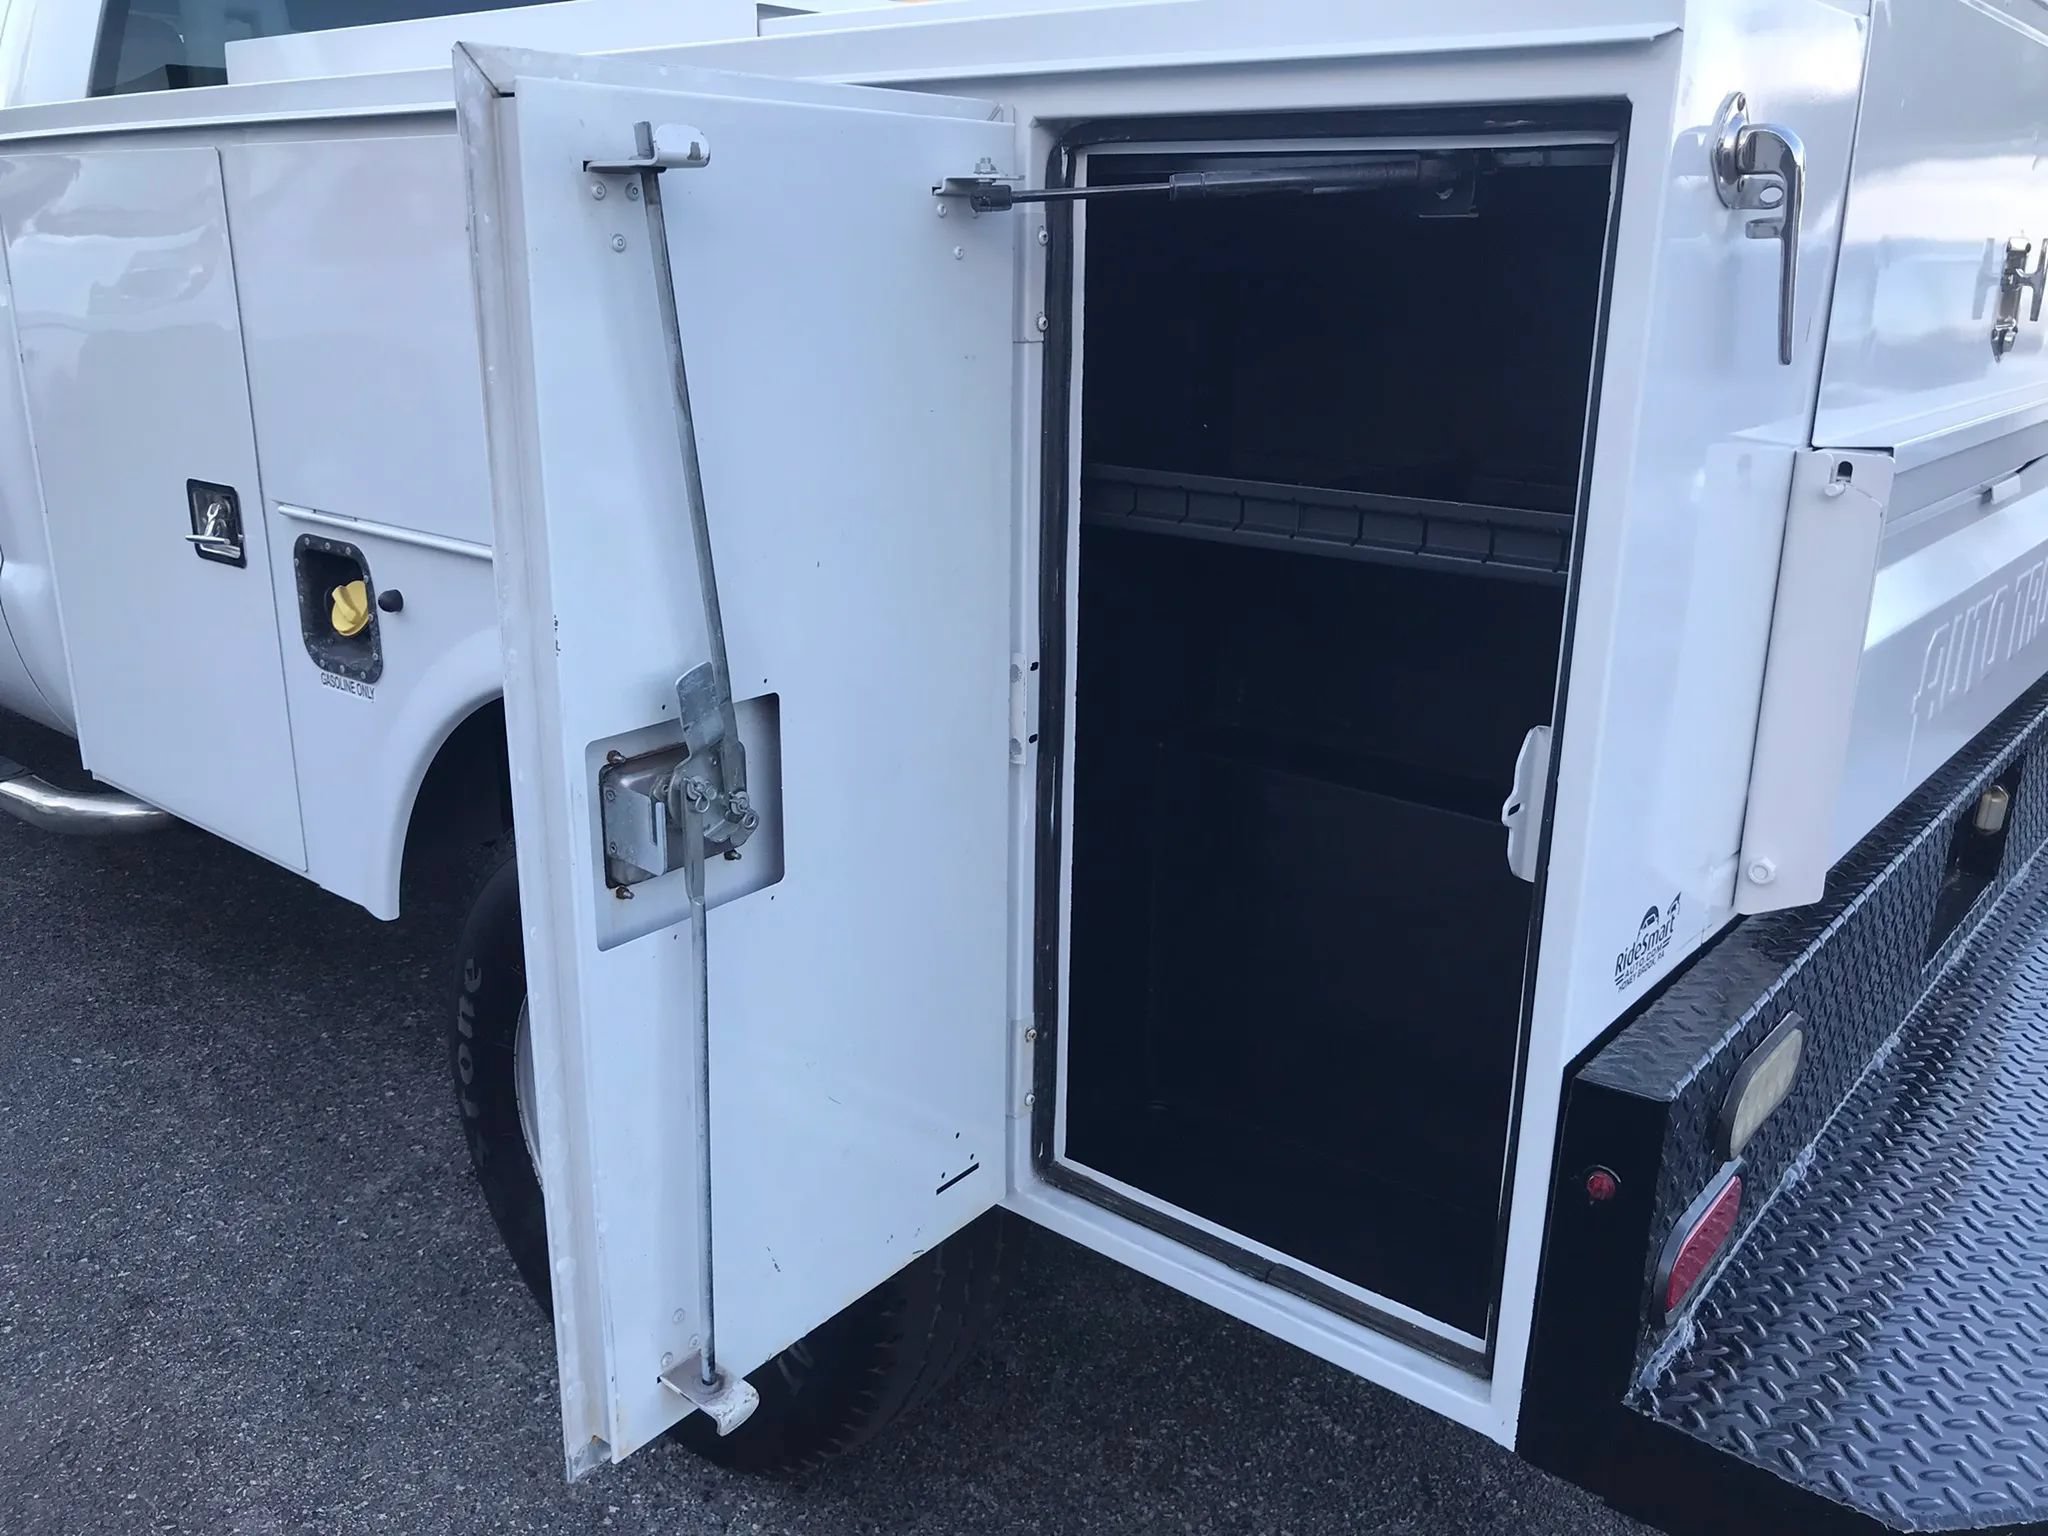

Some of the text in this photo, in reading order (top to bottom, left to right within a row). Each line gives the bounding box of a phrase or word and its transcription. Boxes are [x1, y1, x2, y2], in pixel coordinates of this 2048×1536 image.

[1911, 584, 2009, 720] AUTO
[320, 672, 375, 700] GASOLINE ONLY
[1614, 914, 1676, 977] RideSmart
